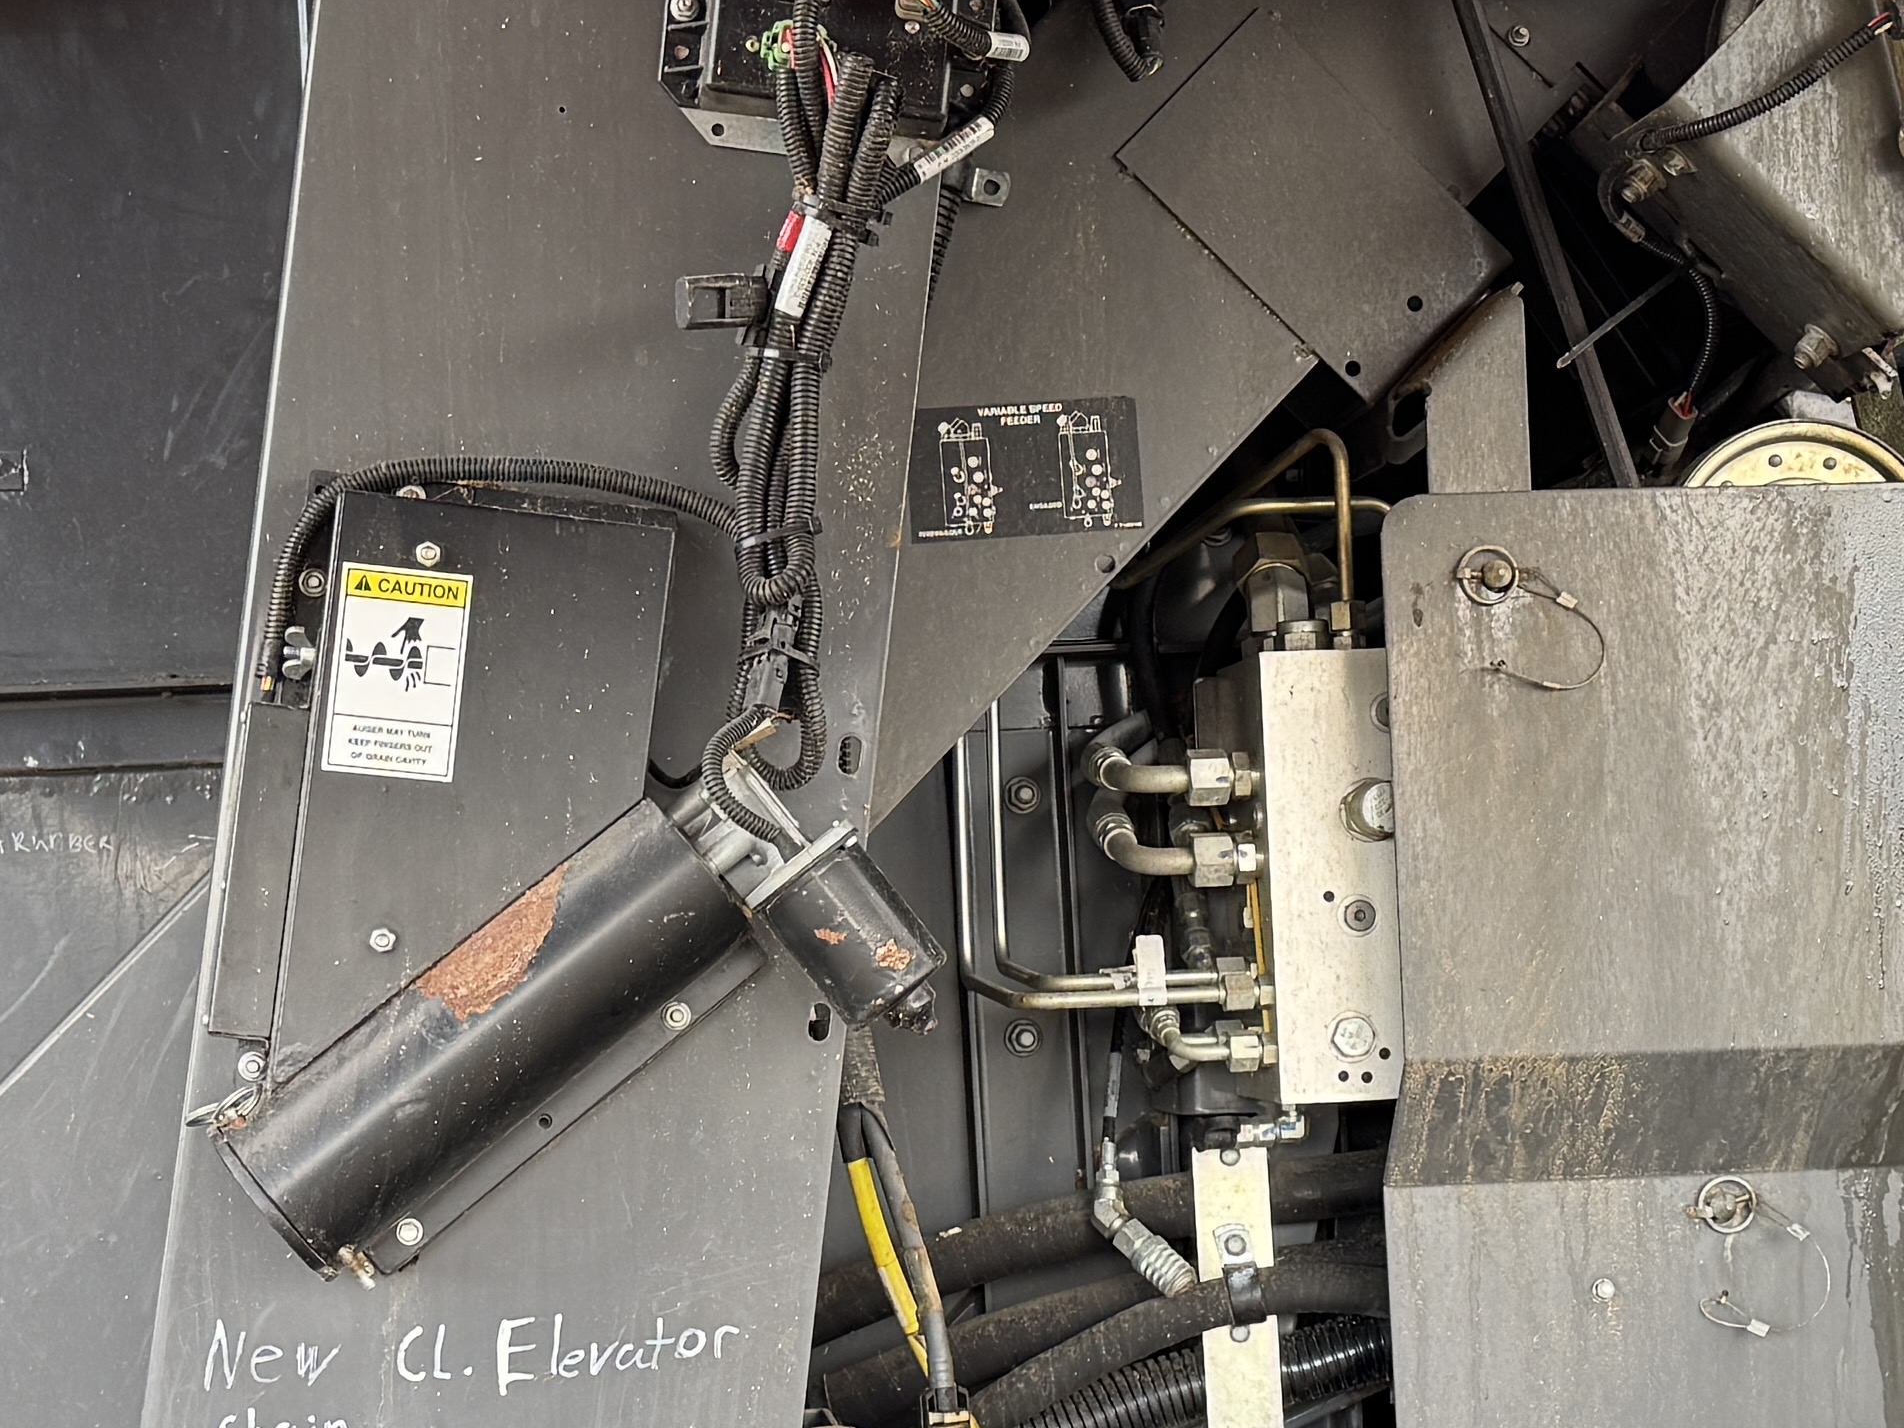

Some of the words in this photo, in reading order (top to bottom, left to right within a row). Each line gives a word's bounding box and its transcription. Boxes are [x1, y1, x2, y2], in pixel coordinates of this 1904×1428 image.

[378, 578, 459, 600] CAUTION
[202, 1316, 344, 1392] New
[496, 1313, 741, 1397] Elevator
